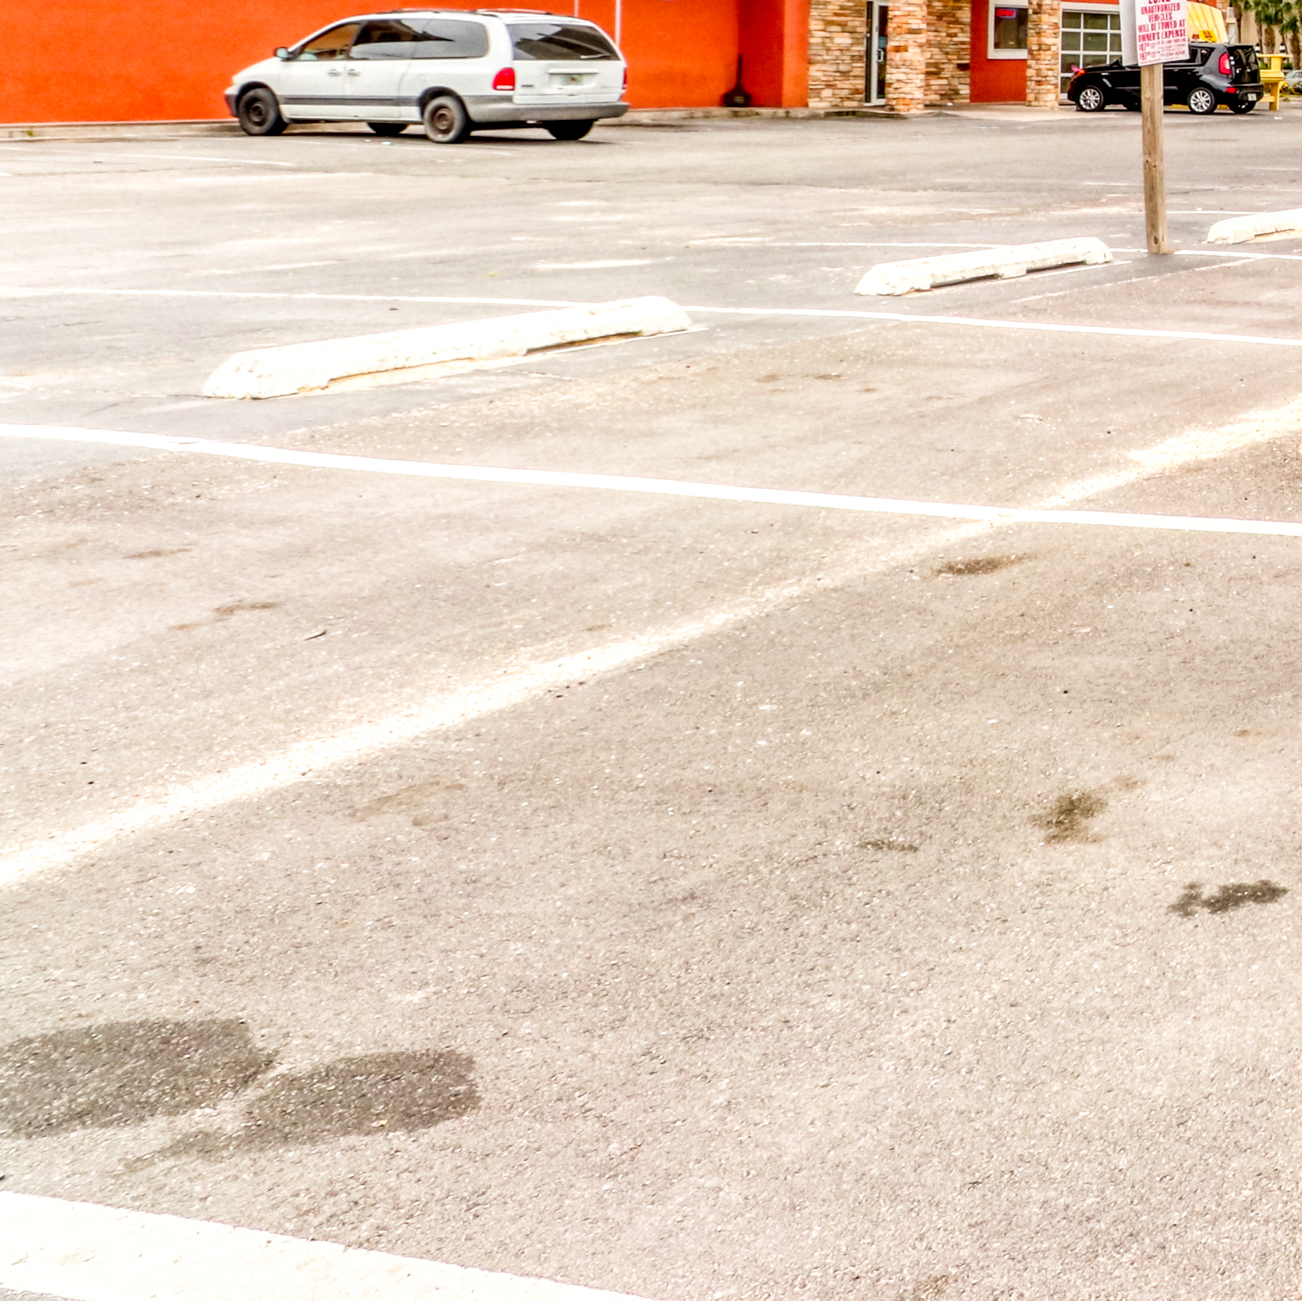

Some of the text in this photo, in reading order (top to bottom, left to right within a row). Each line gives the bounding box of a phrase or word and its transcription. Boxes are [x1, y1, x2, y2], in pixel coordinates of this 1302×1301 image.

[1141, 3, 1180, 14] UNAUTHORIZED
[1148, 12, 1172, 22] VEHICLES
[1138, 19, 1185, 32] WILL BE TOWED AT
[1161, 28, 1186, 39] EXPENSE
